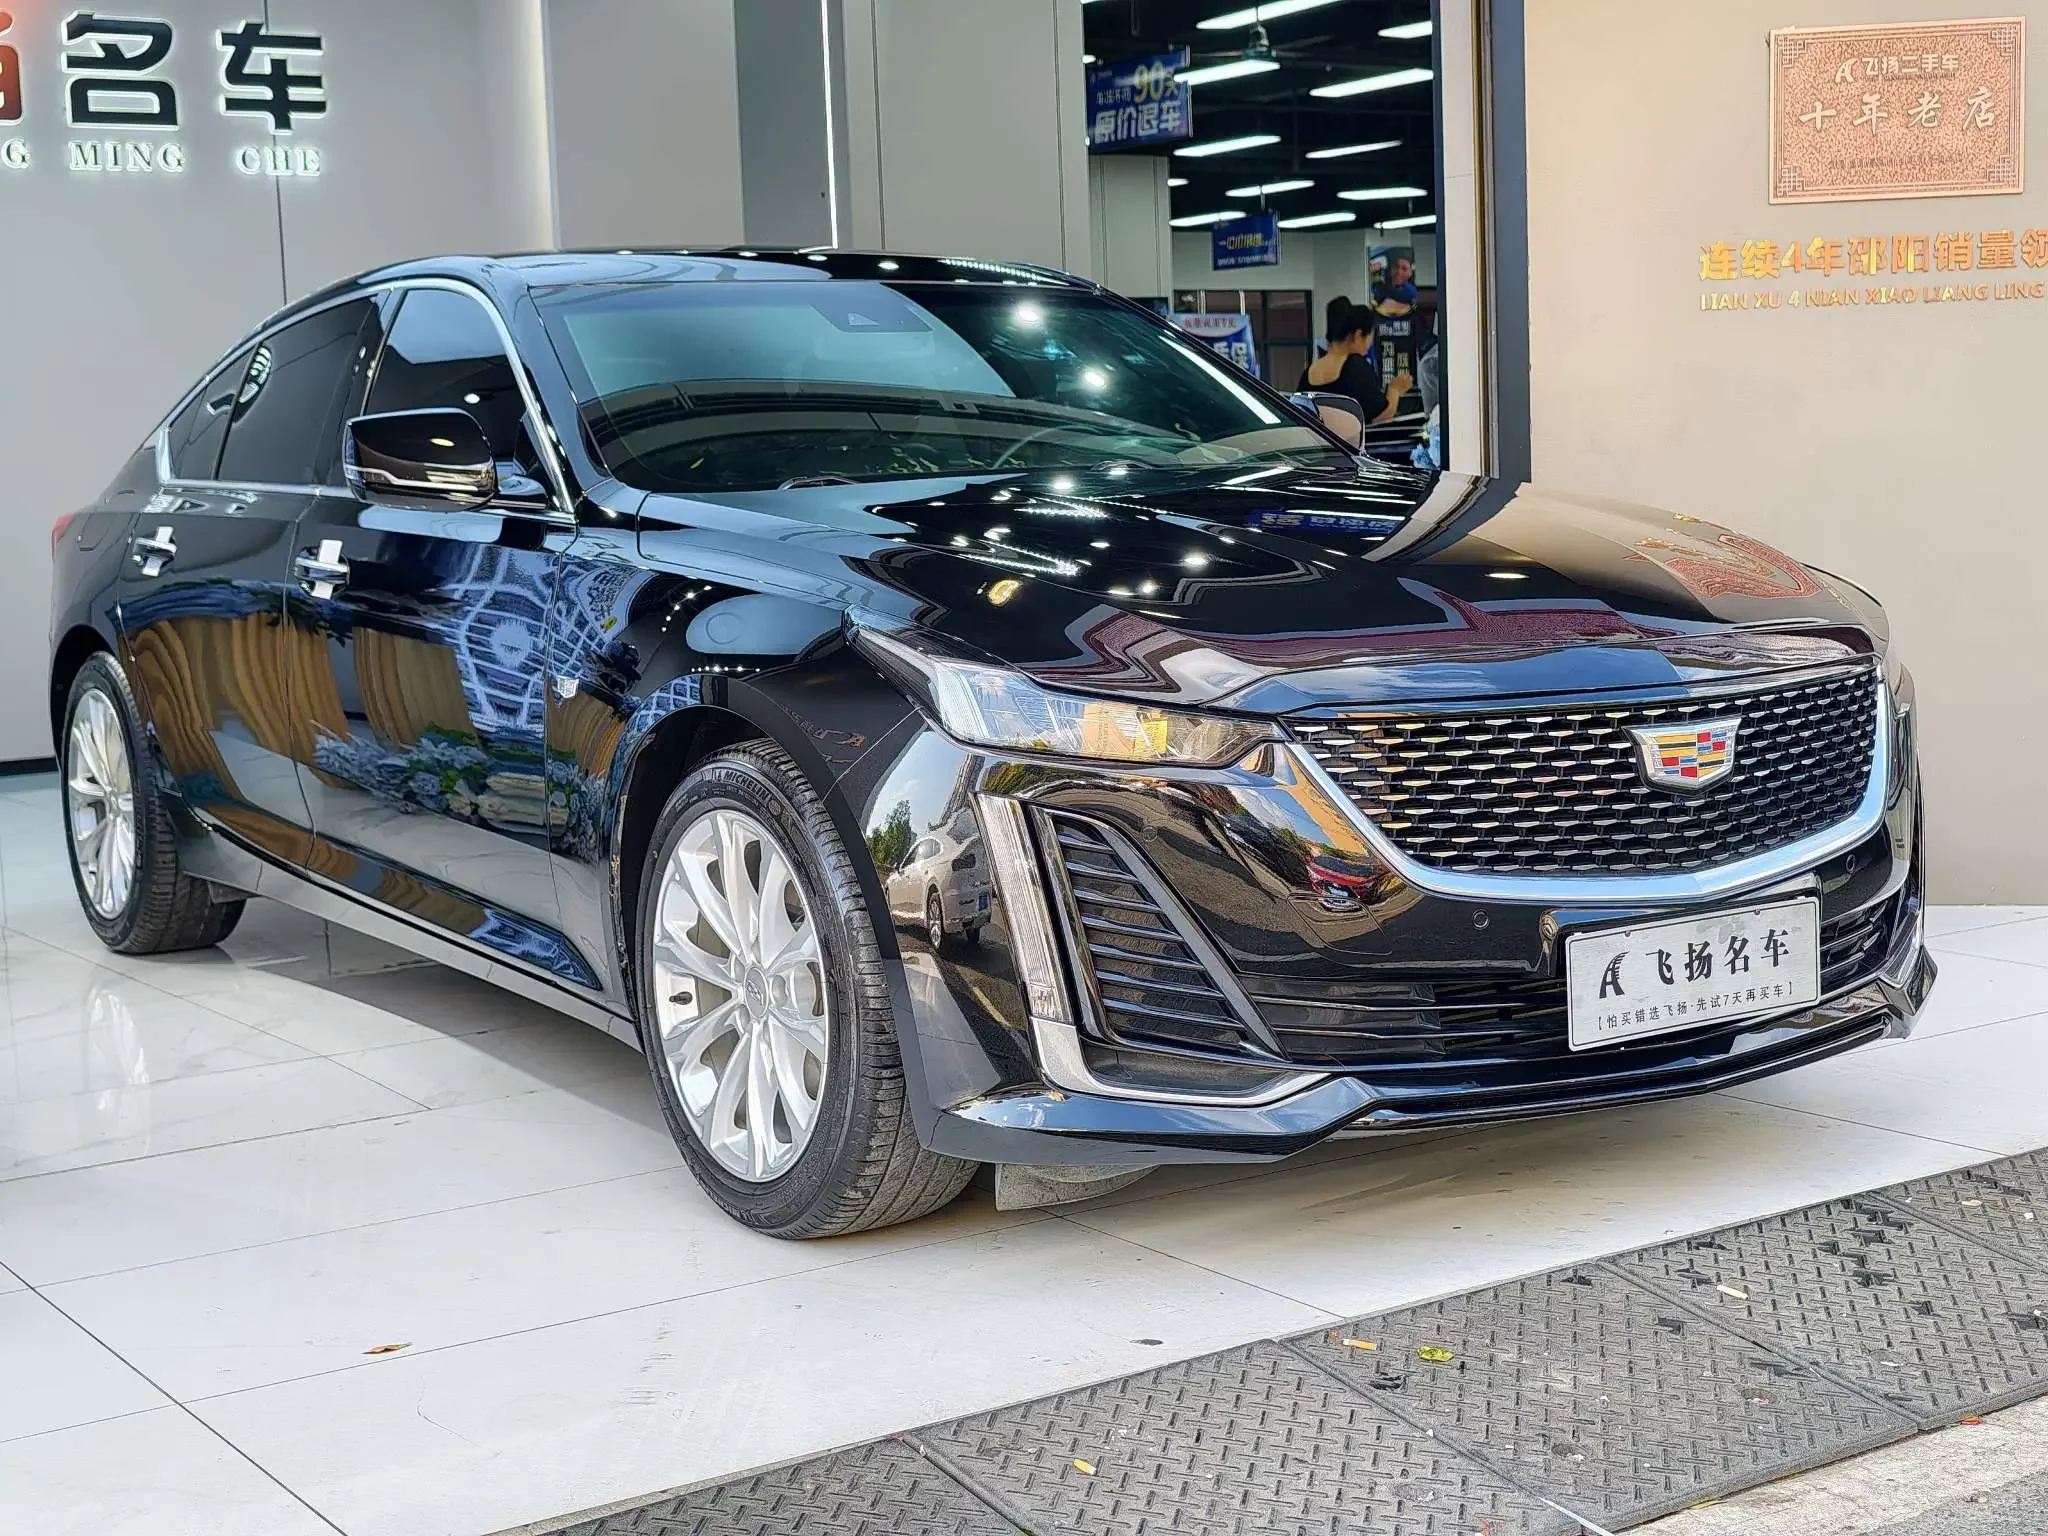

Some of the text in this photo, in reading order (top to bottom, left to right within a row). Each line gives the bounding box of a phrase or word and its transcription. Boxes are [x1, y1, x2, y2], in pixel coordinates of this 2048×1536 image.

[1861, 53, 1958, 75] 飞扬二手车
[1094, 100, 1181, 144] 原价退车
[1799, 86, 1999, 135] 十年老店
[68, 141, 185, 172] MING
[235, 146, 322, 176] CHE
[1700, 291, 1748, 311] LIAN
[1754, 291, 1782, 309] XU
[1788, 288, 1800, 307] 4
[1806, 287, 1859, 307] NIAN
[1865, 287, 1917, 304] XIAO
[1923, 285, 1988, 303] LIANG
[723, 769, 771, 802] MICHELIN
[1646, 929, 1790, 985] 飞扬名车
